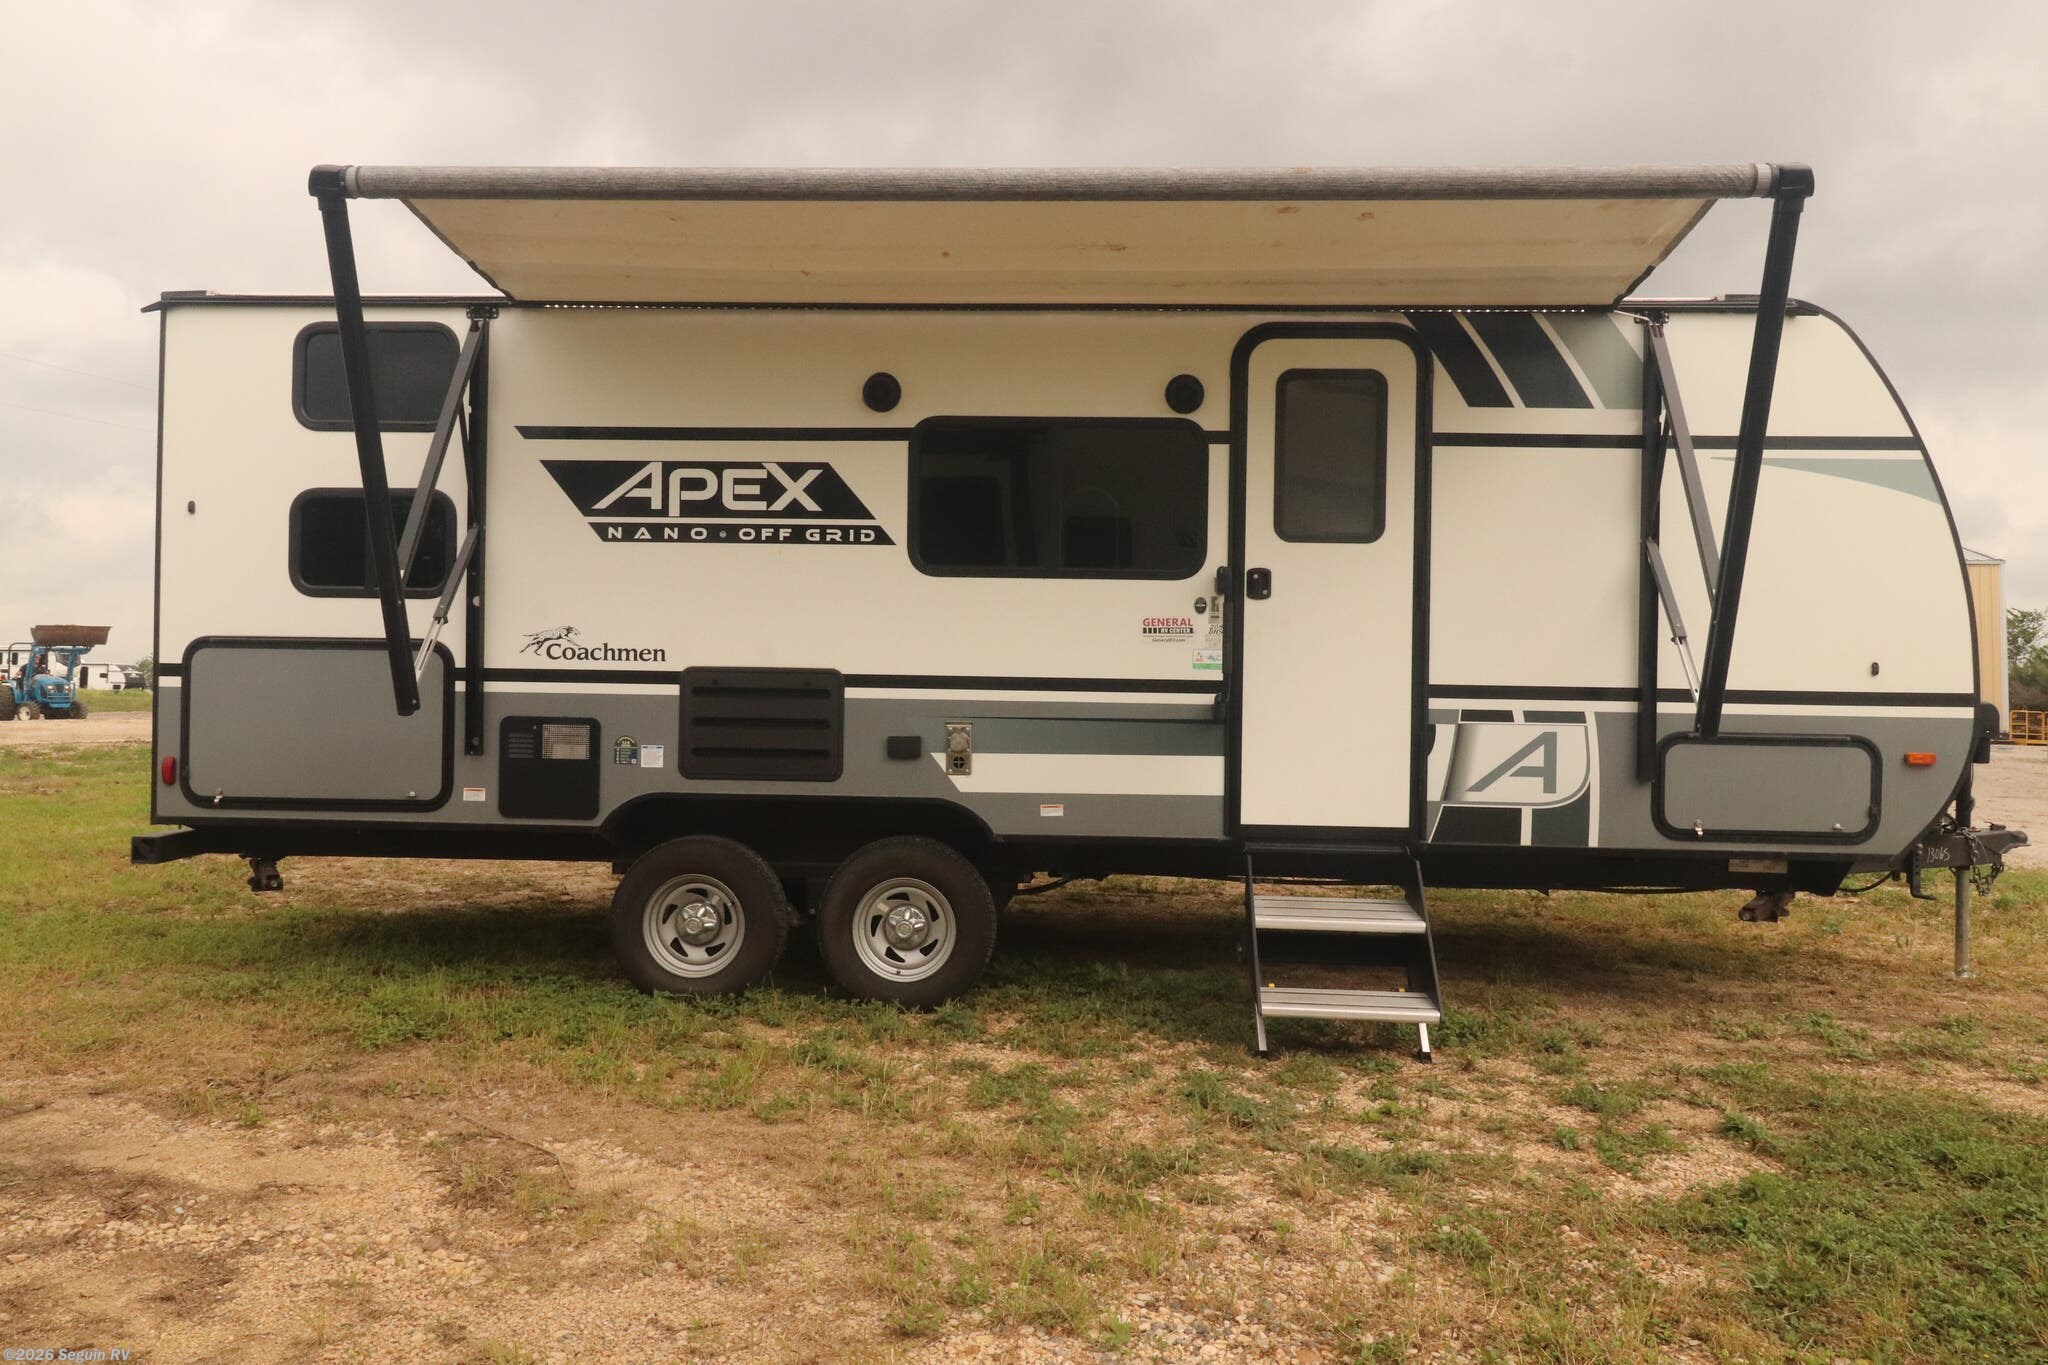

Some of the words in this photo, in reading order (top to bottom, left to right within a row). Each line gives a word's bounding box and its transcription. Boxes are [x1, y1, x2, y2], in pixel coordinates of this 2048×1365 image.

[592, 461, 824, 517] APEX
[607, 526, 708, 541] NANO
[738, 527, 792, 542] OFF
[805, 528, 876, 543] GRID
[1143, 618, 1193, 627] GENERAL
[545, 642, 667, 663] Coachmen
[1465, 732, 1557, 794] A
